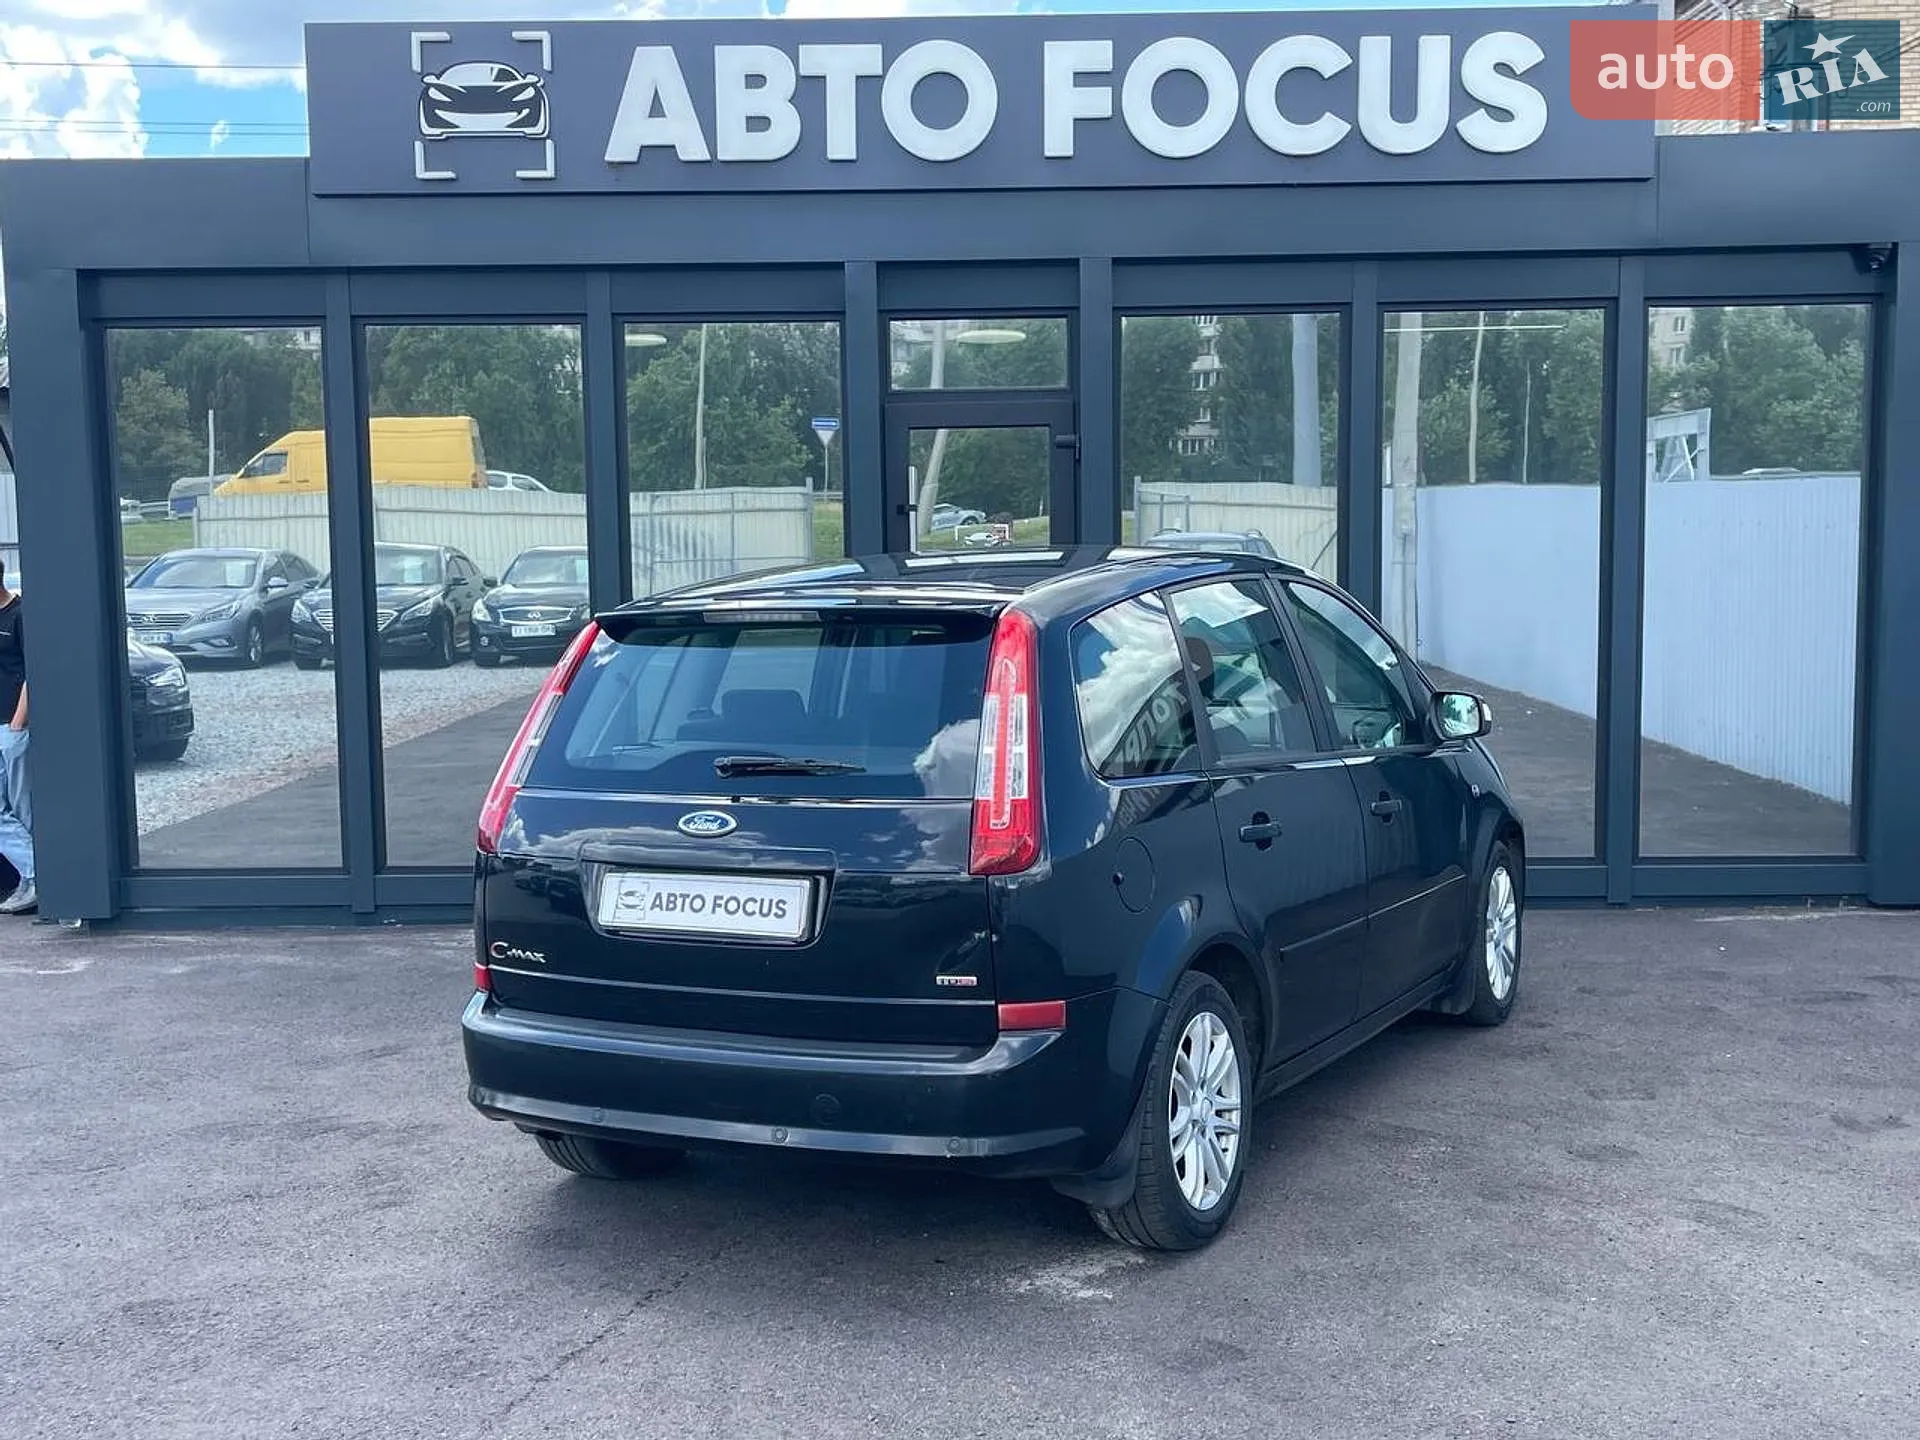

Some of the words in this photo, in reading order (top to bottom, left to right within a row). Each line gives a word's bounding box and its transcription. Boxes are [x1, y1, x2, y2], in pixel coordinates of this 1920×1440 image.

[604, 40, 998, 164] АВТО
[1043, 31, 1549, 160] FOCUS
[687, 815, 722, 830] Ford
[650, 891, 706, 914] АВТО
[711, 895, 788, 919] FOCUS
